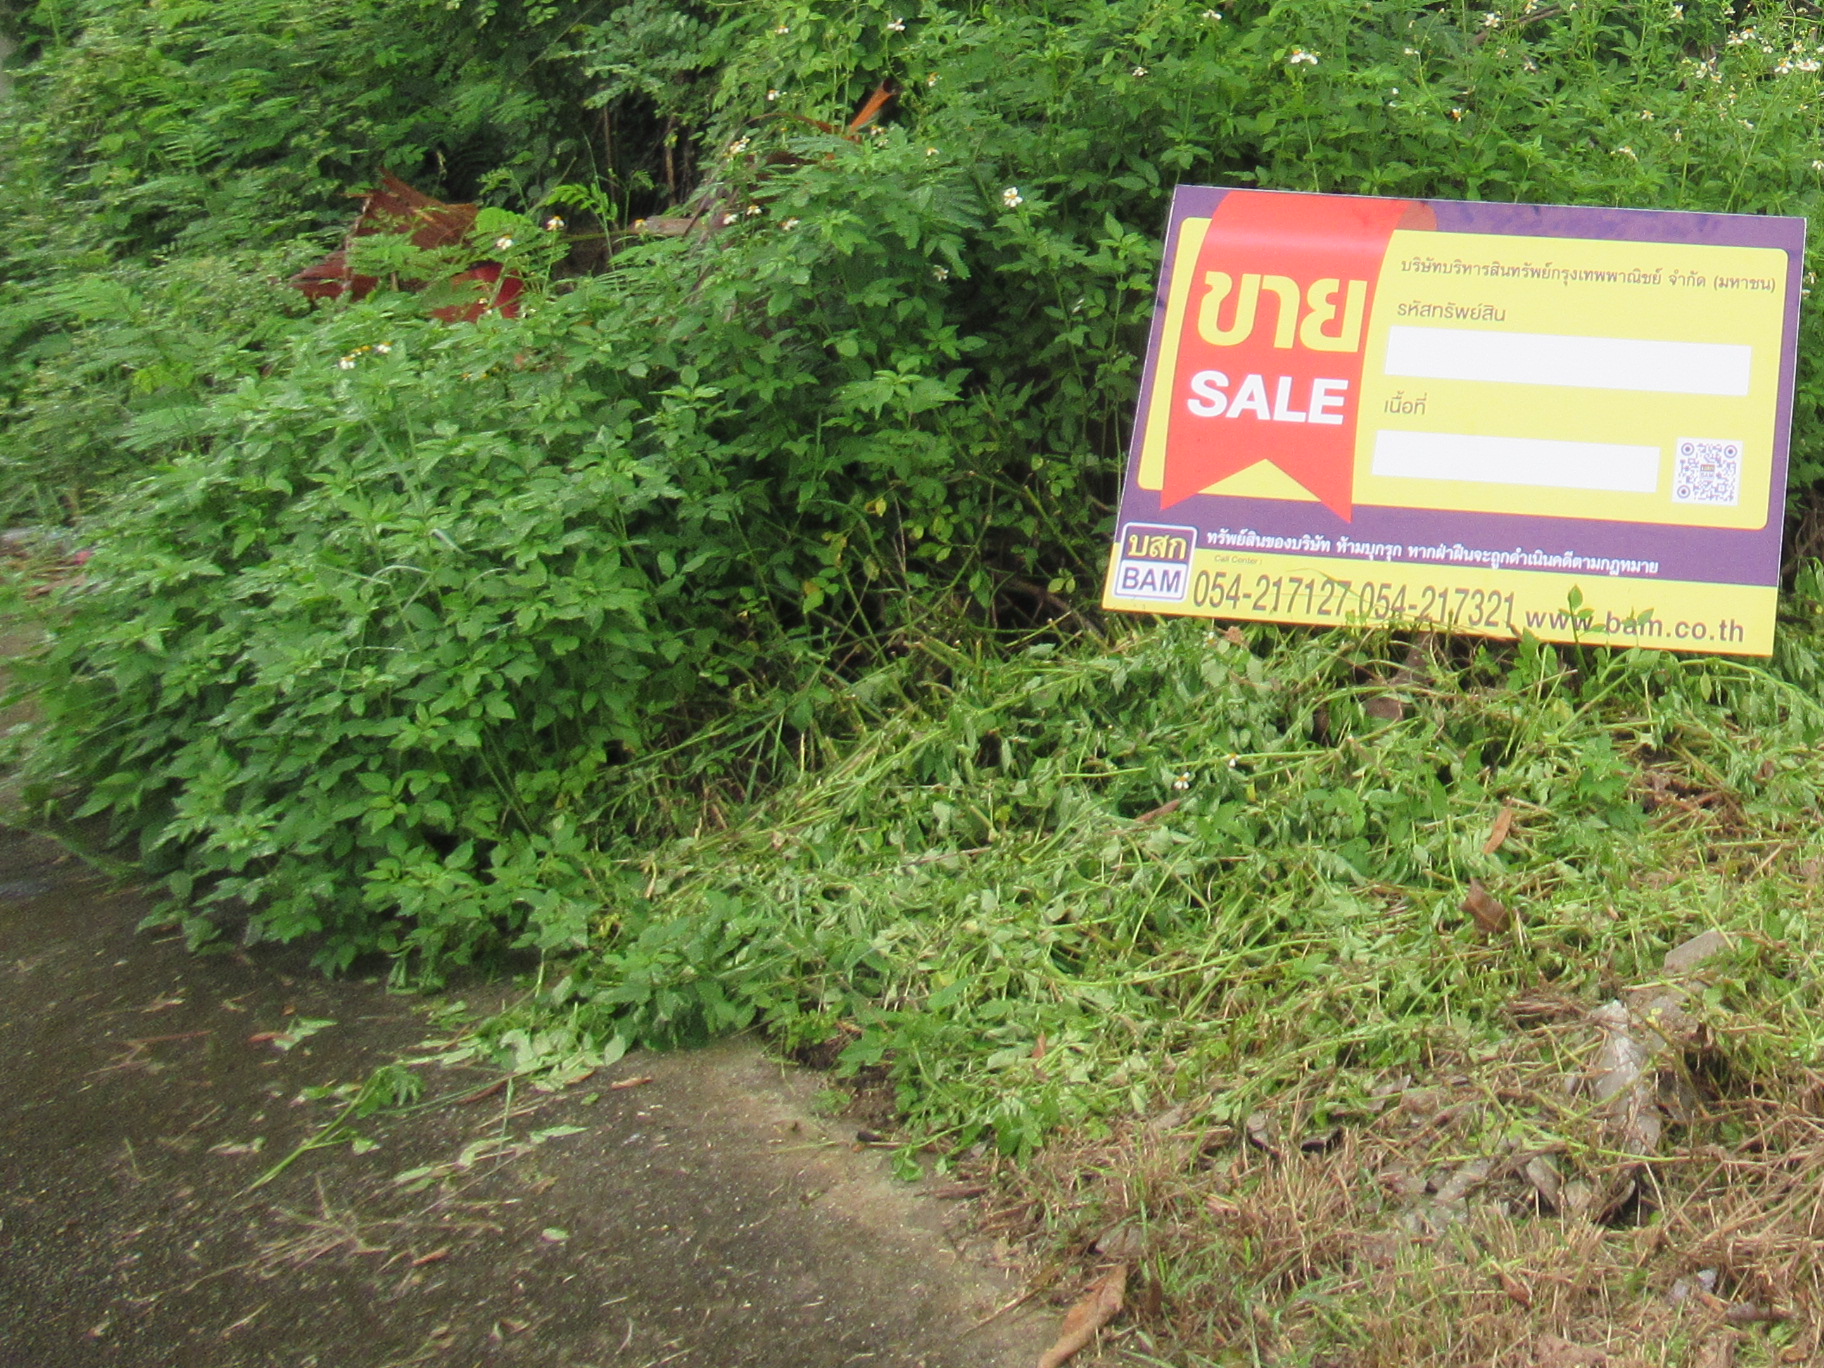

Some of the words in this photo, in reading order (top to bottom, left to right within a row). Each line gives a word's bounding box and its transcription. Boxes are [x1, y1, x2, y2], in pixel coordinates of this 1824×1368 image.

[1668, 269, 1706, 288] จำกัด
[1713, 275, 1776, 293] (มหาชน)
[1197, 271, 1368, 353] ขาย
[1397, 300, 1506, 322] รหัสทรัพย์สิน
[1187, 370, 1349, 425] SALE
[1384, 390, 1427, 415] เนื้อที่
[1127, 534, 1188, 560] บสก
[1207, 528, 1331, 552] ทรัพย์สินของบริษัท
[1336, 536, 1403, 562] ห้ามบุกรุก
[1122, 566, 1182, 593] BAM
[1525, 610, 1744, 643] wwwbam.co.th
